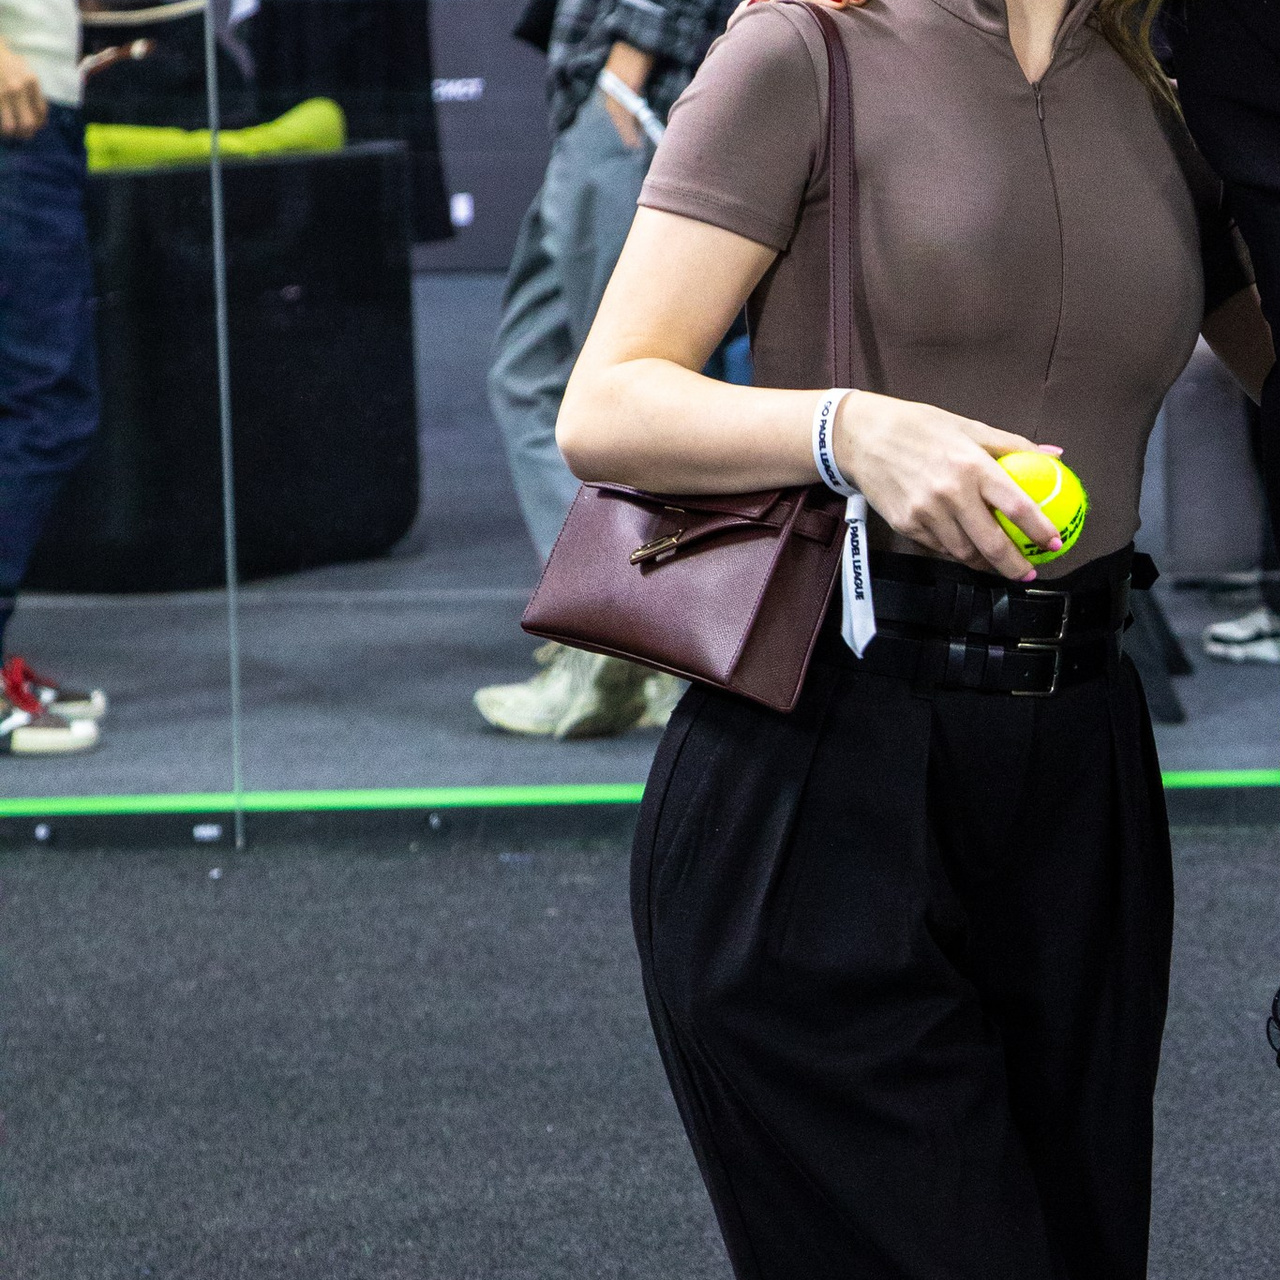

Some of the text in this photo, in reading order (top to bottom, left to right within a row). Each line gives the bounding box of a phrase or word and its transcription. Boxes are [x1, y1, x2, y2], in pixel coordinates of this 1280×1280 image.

[818, 400, 842, 488] GO PADEL LEAGUE
[850, 525, 861, 558] PADEL
[852, 558, 865, 601] LEAGUE
